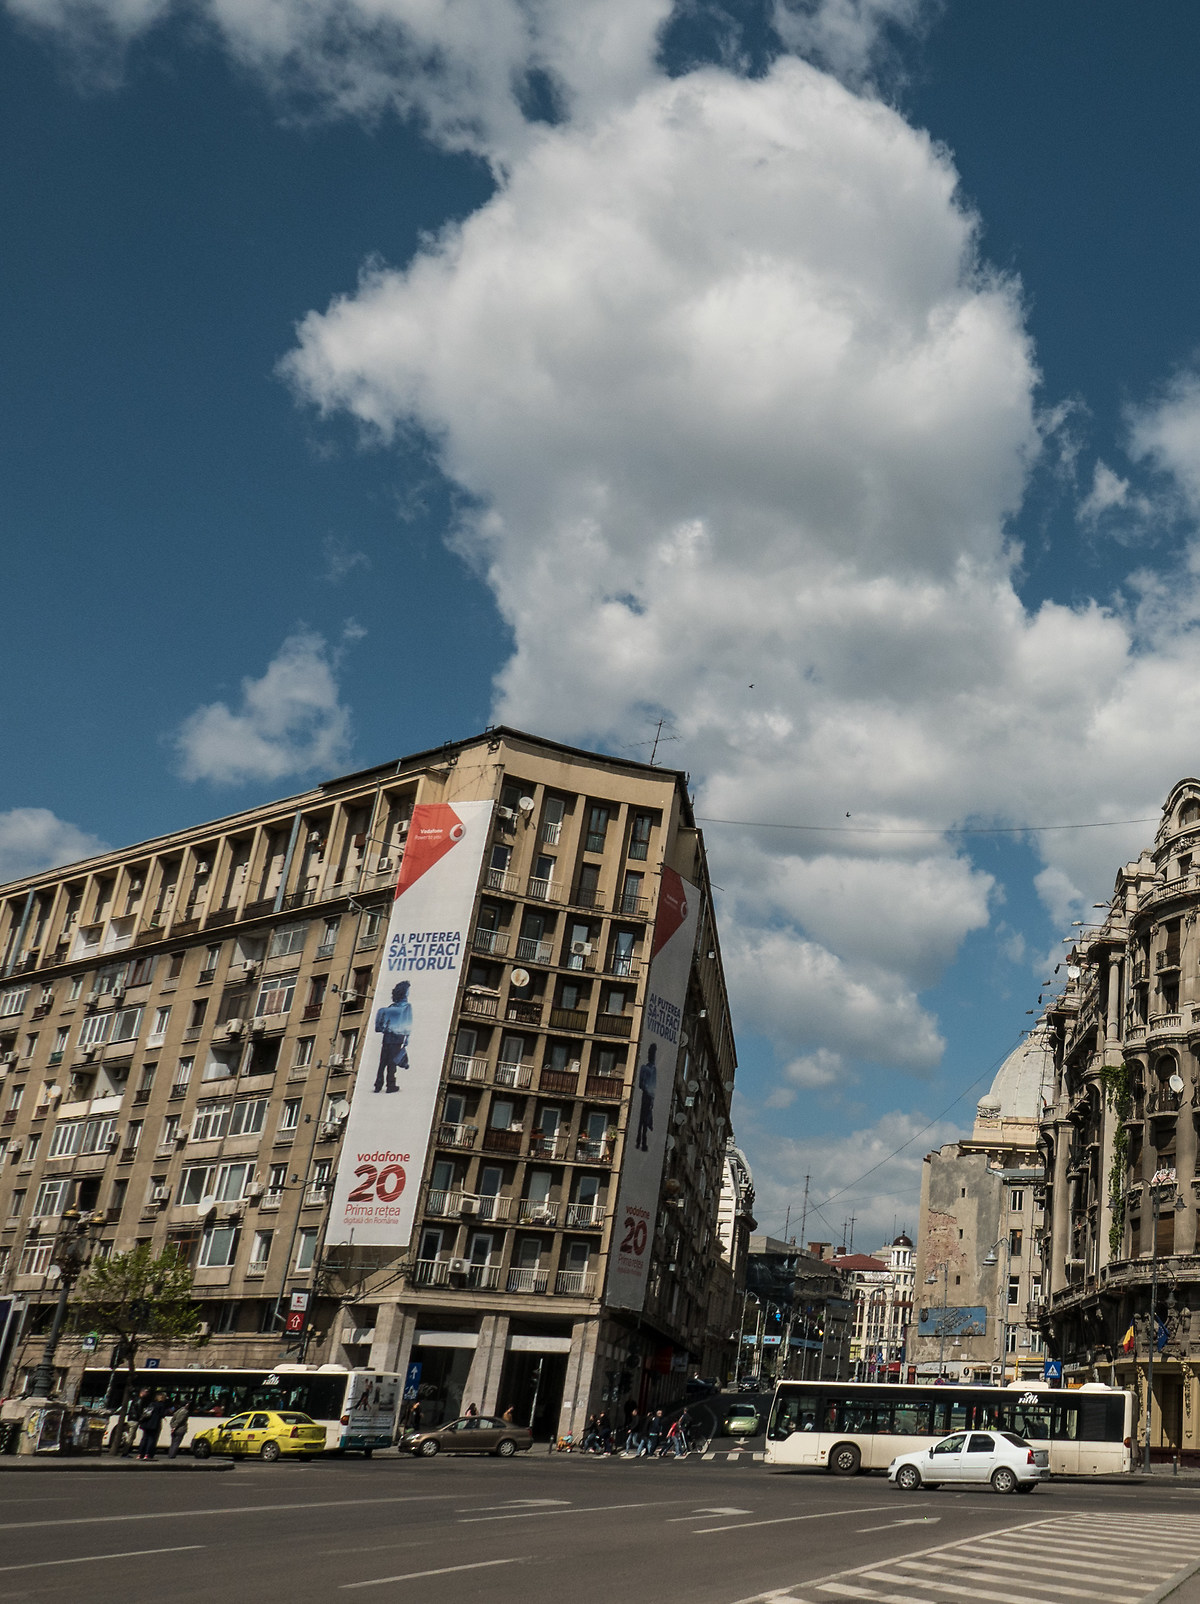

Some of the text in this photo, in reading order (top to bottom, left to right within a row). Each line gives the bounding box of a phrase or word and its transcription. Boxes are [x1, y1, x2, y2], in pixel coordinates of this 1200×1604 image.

[392, 931, 461, 944] AI PUTEREA
[428, 943, 460, 956] FACI
[388, 957, 456, 971] VIITORUL
[357, 1150, 410, 1162] vodafone
[348, 1164, 406, 1202] 20
[344, 1204, 374, 1216] Prima
[626, 1205, 650, 1220] vodafone
[620, 1216, 648, 1256] 20
